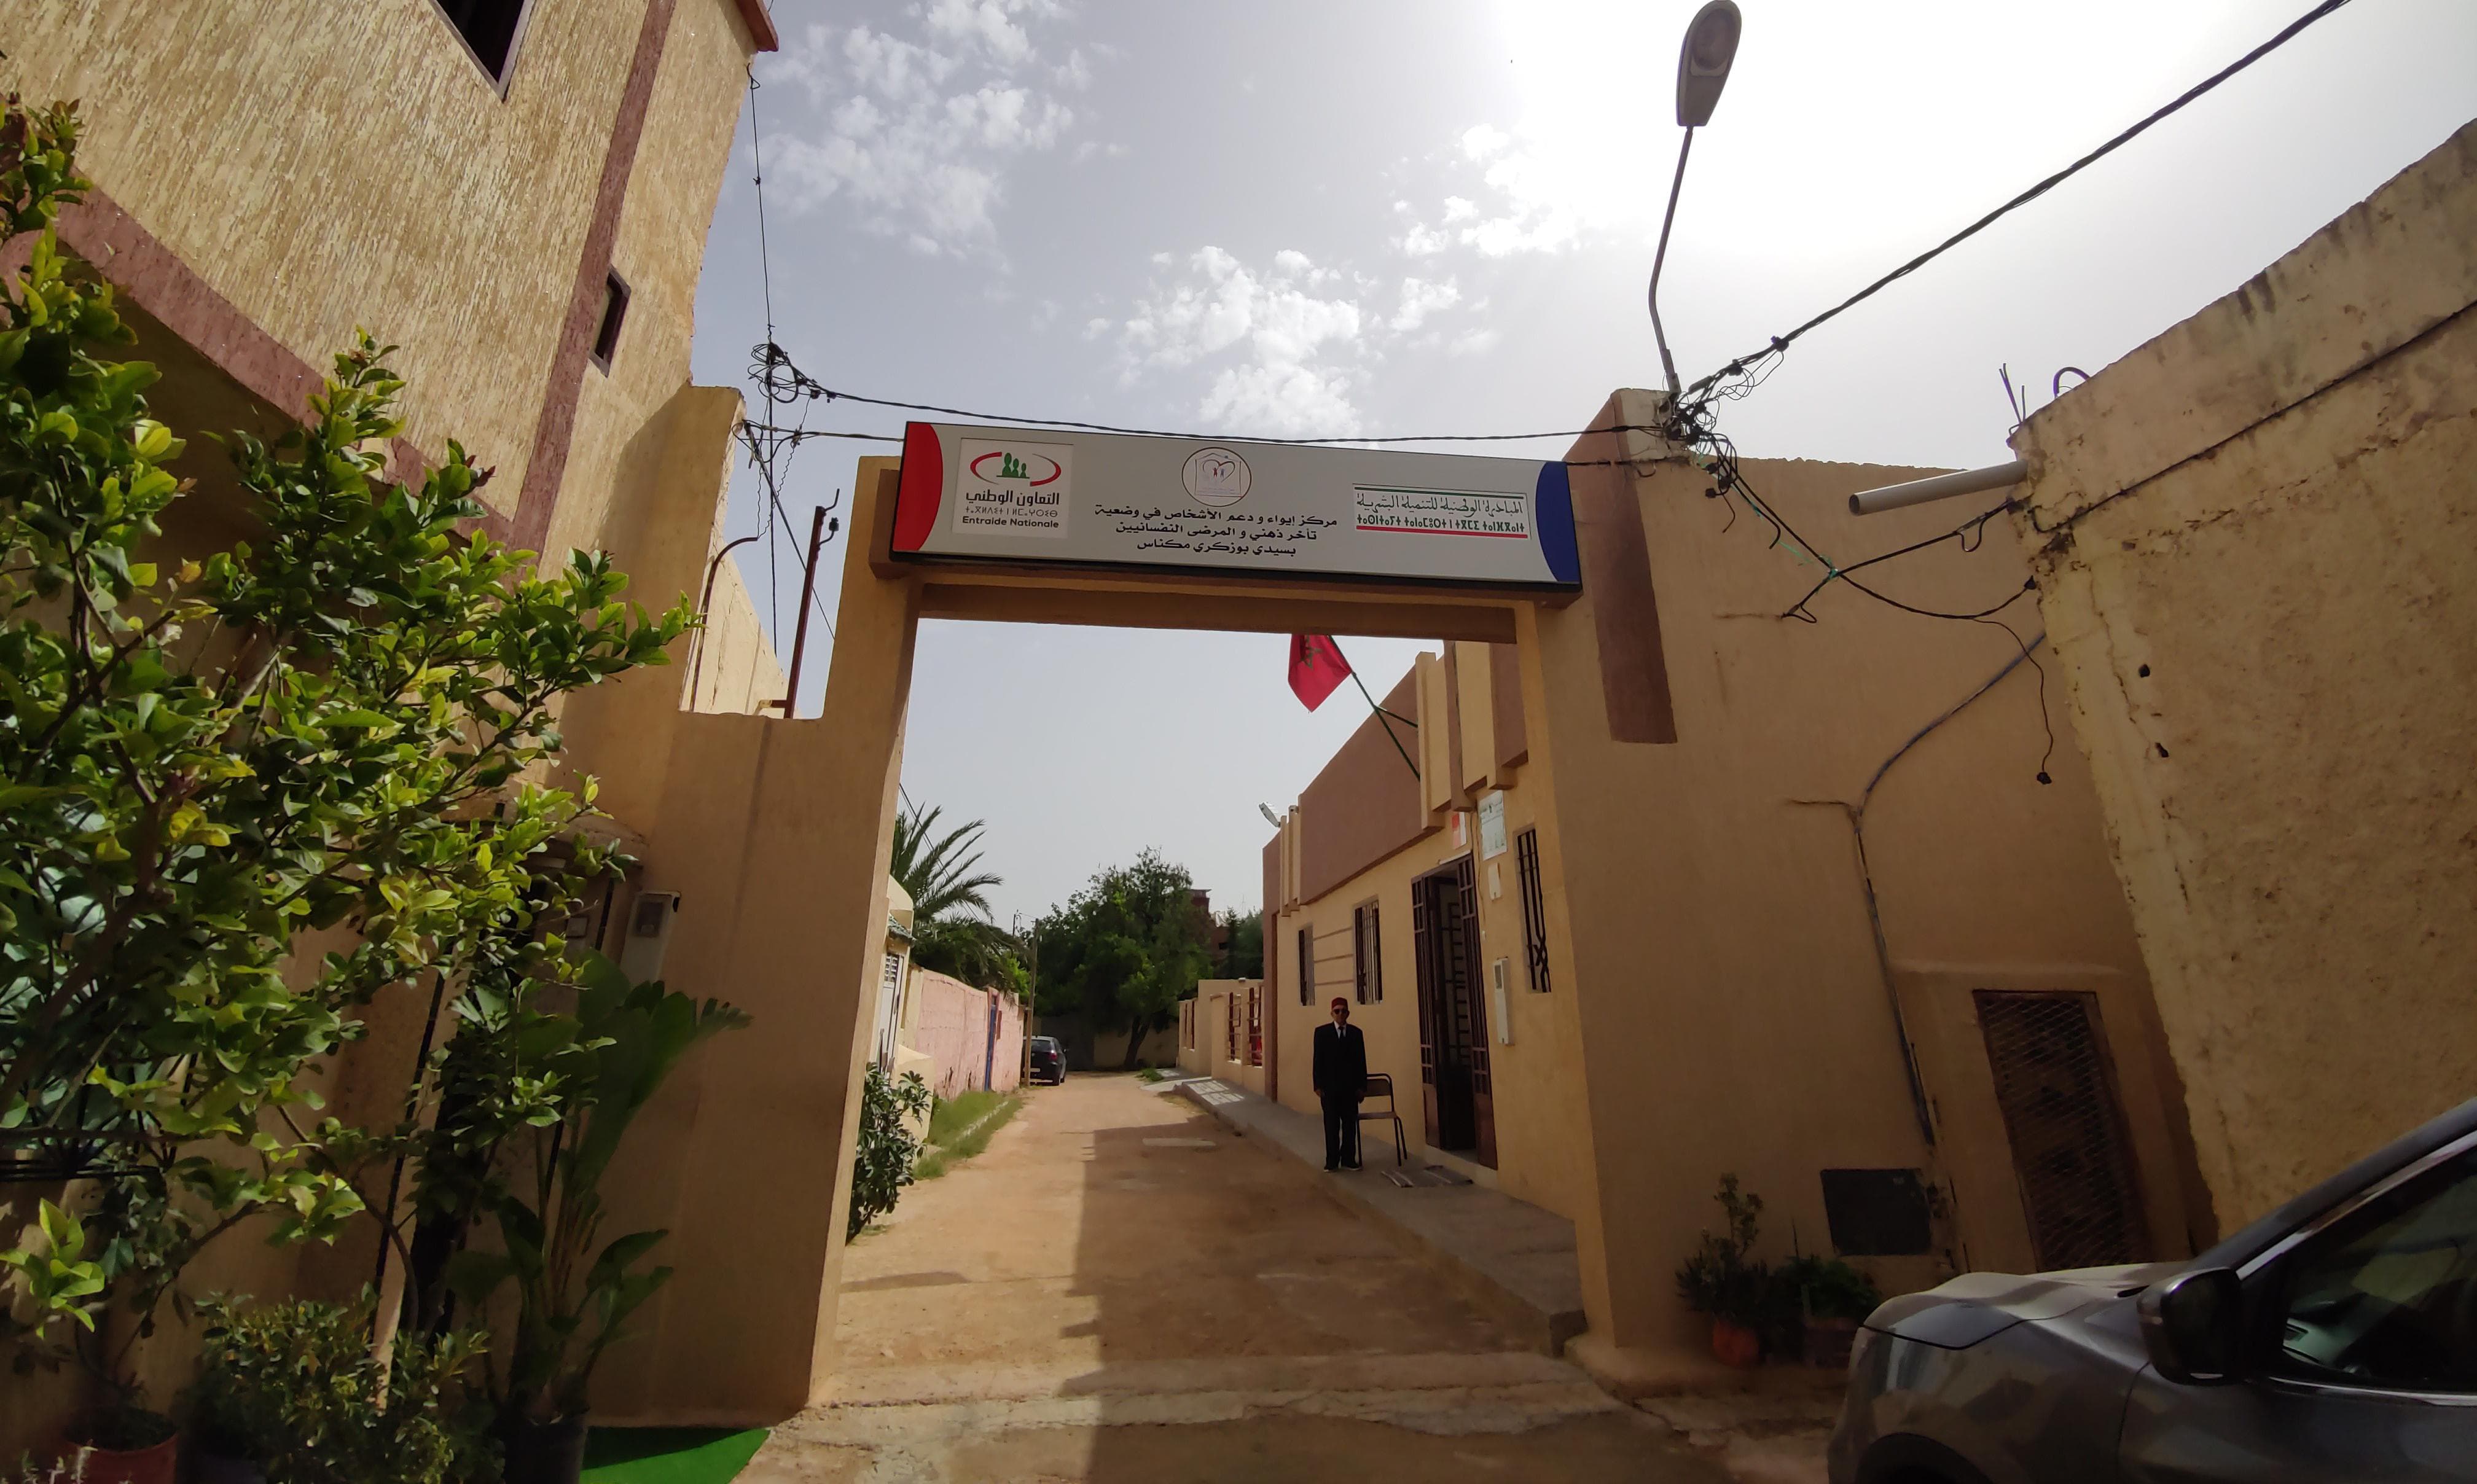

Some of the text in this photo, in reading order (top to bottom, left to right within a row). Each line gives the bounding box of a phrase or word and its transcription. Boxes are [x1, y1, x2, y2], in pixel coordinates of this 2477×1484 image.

[966, 489, 1060, 507] التعاون الوطني
[1356, 493, 1399, 514] البشرية
[1095, 504, 1140, 518] وضعية
[1143, 507, 1161, 520] في
[1164, 508, 1221, 520] الأشخاص
[1440, 497, 1481, 518] الوطنية
[962, 515, 1059, 528] Entraide Nationale
[1267, 515, 1295, 526] إيواء
[1298, 515, 1337, 528] مركز
[1116, 521, 1317, 541] تأخر ذهني و المرضى النفسانيين
[1137, 538, 1296, 556] بسيدي بوزكري مكناس
